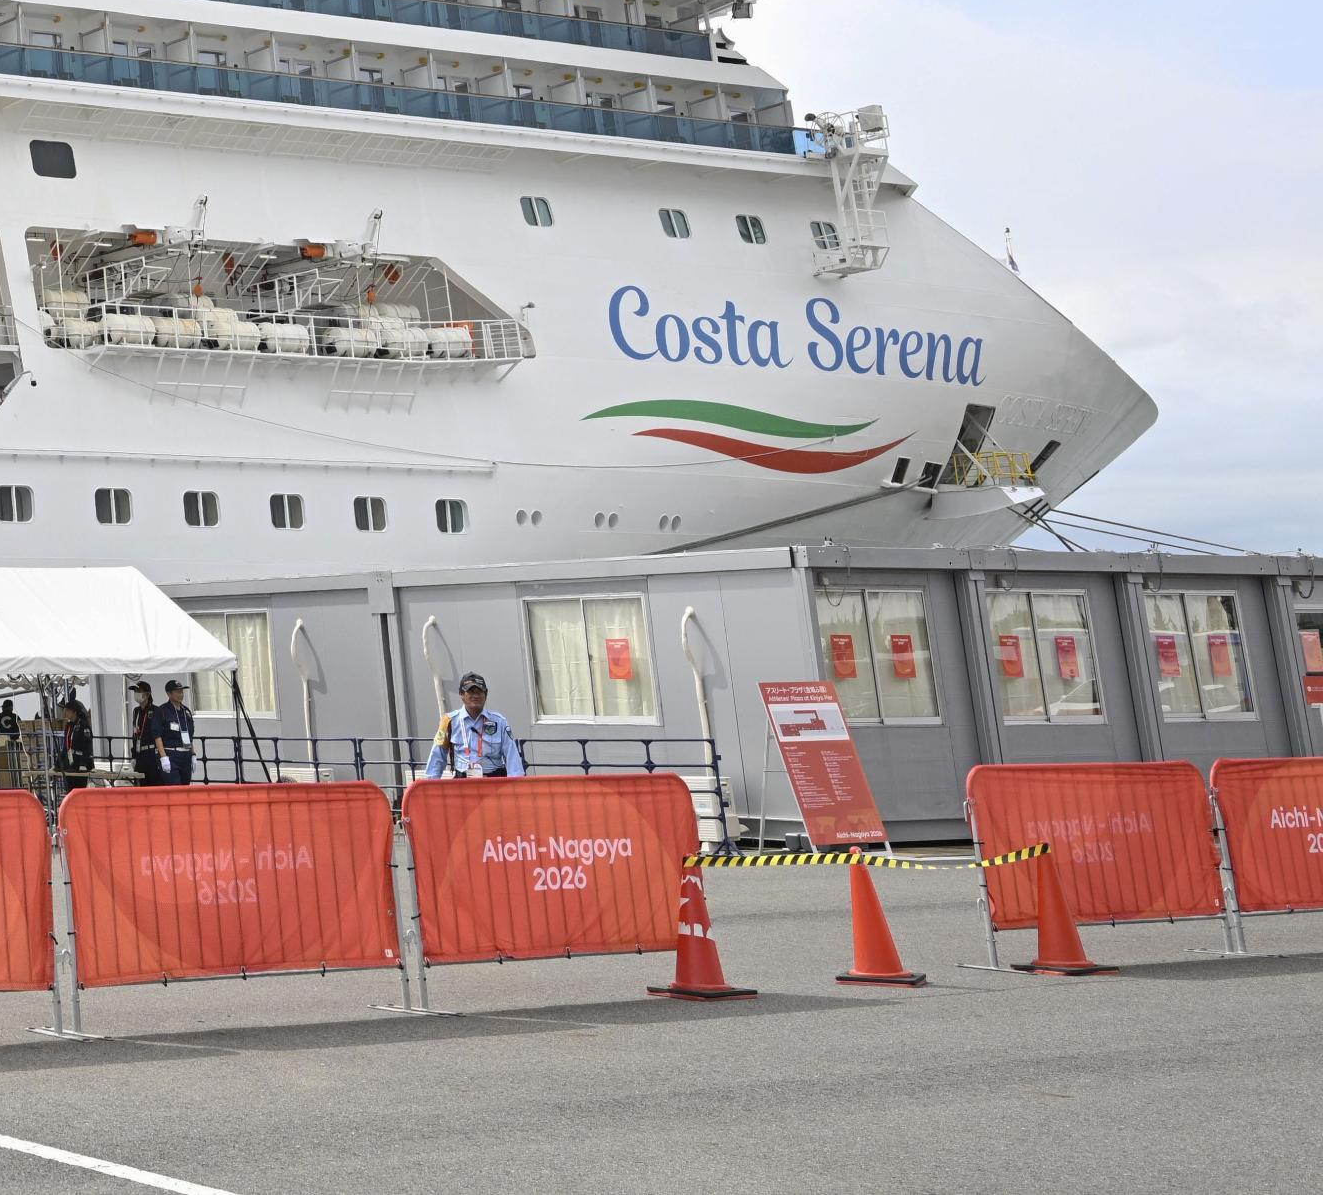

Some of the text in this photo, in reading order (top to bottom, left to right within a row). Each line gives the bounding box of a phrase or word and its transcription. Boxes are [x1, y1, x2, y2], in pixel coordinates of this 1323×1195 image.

[608, 285, 987, 387] Costa Serena
[482, 834, 633, 866] Aichi-Nagoya
[533, 865, 587, 891] 2026
